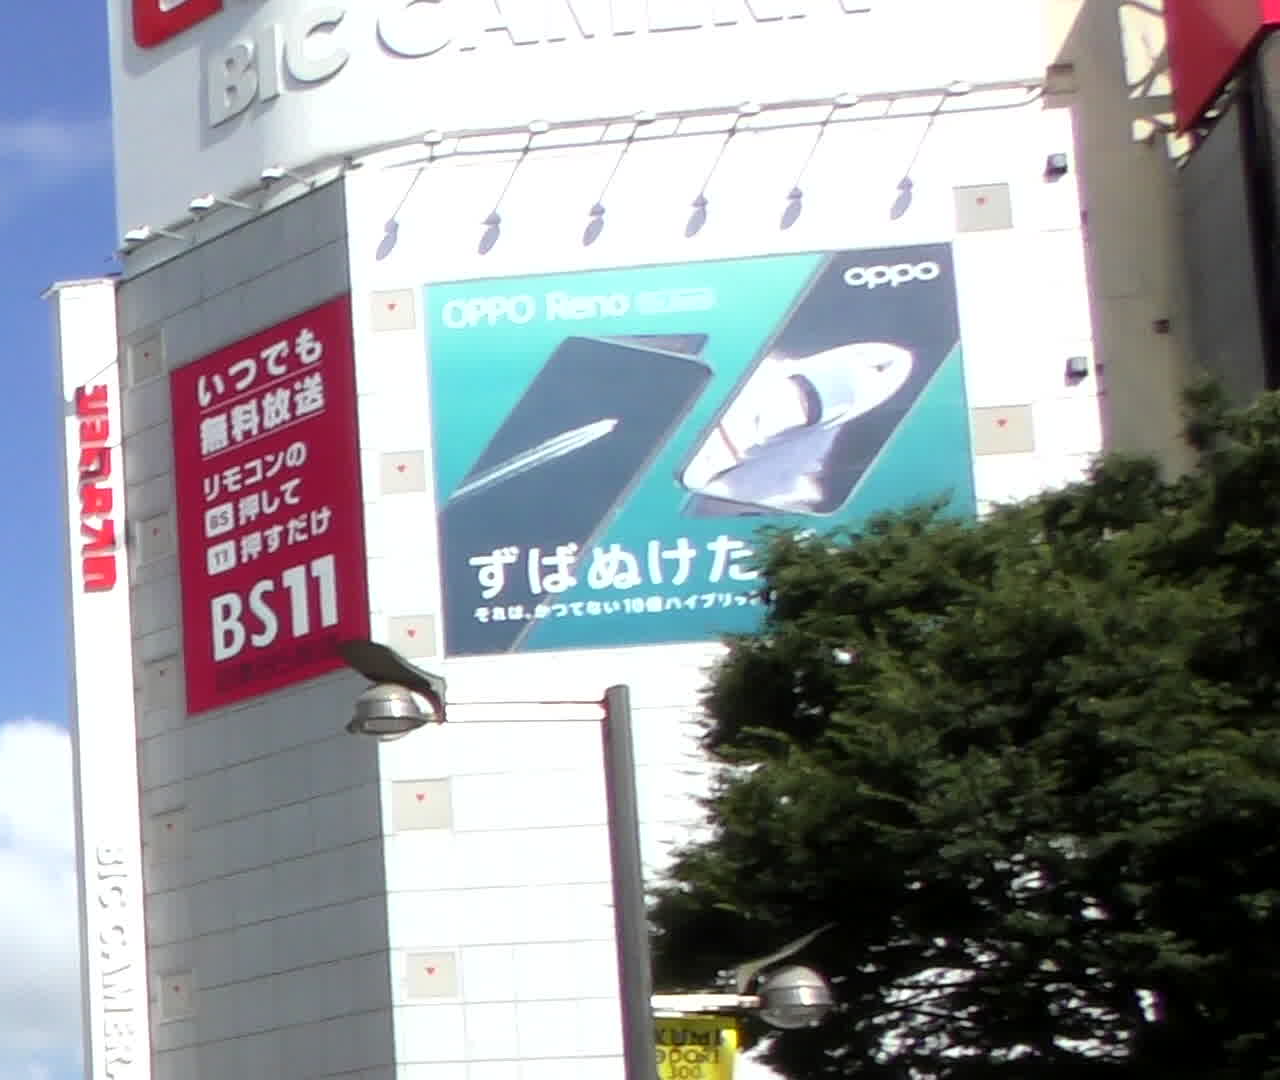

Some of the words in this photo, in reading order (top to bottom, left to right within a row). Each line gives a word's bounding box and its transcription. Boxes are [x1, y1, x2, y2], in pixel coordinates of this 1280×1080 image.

[209, 10, 348, 129] BIC
[843, 261, 939, 289] oppo
[442, 294, 536, 328] OPPO
[197, 328, 323, 407] いつでも
[200, 373, 324, 455] 無料放送
[204, 441, 306, 501] リモコンの
[239, 479, 302, 521] 押して
[241, 507, 332, 563] 押すだけ
[469, 534, 760, 600] ずばぬけた
[211, 554, 339, 662] BS11
